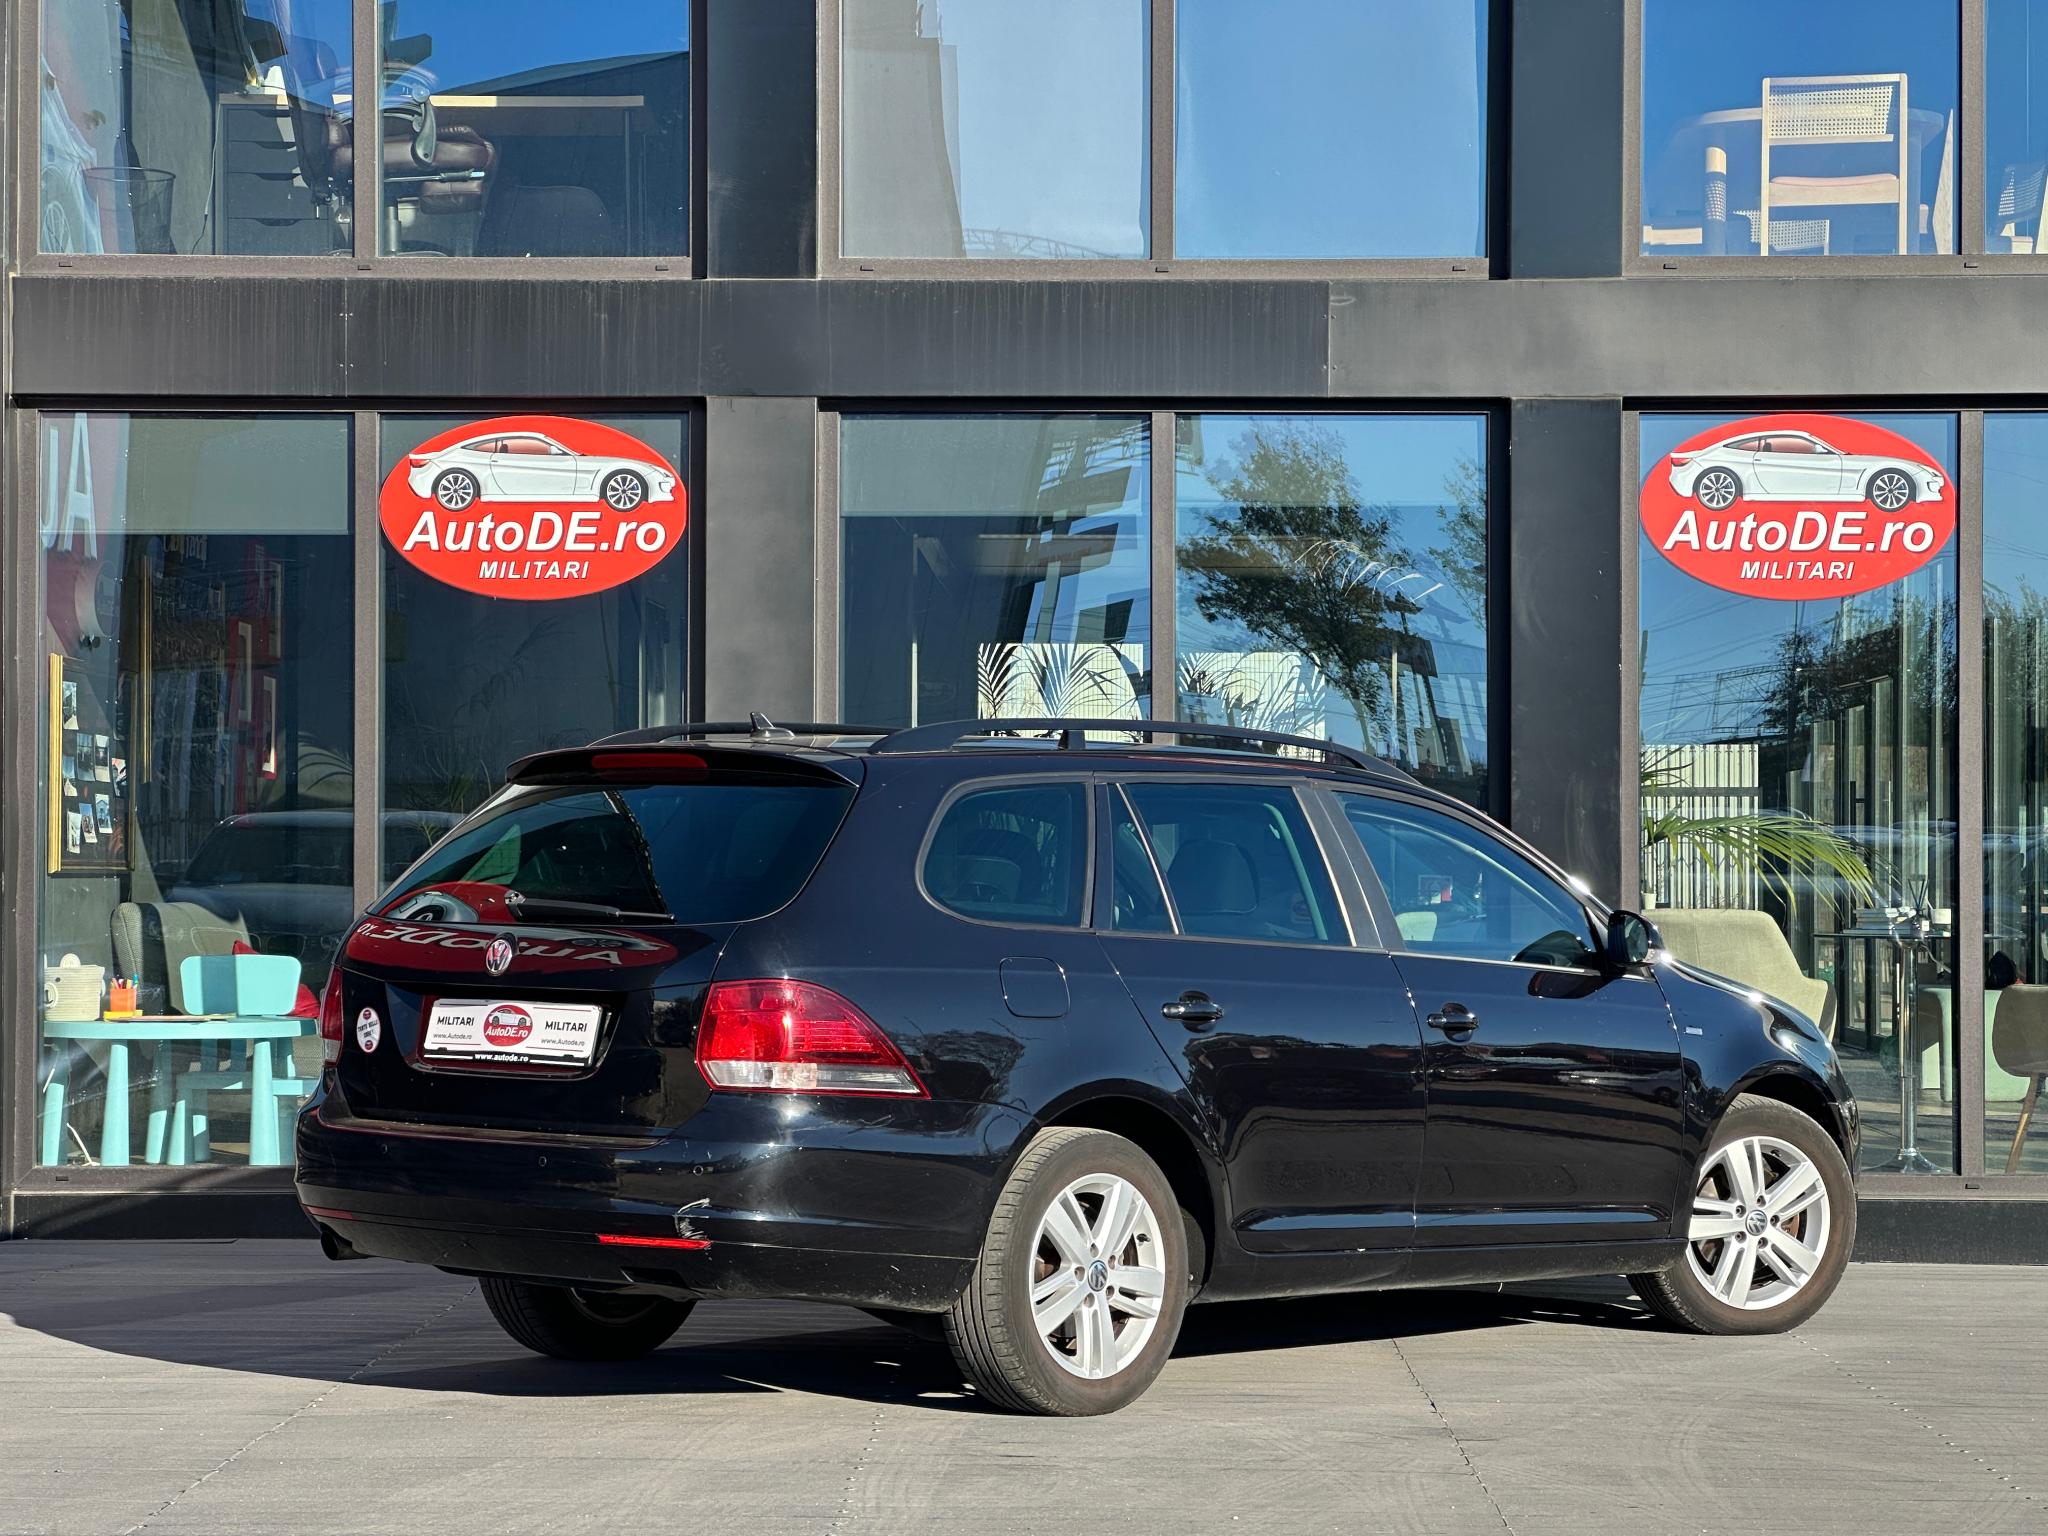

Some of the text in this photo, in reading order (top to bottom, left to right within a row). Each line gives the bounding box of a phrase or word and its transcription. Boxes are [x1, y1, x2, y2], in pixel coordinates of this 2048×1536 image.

[402, 511, 667, 553] AutoDE.ro
[1663, 510, 1935, 553] AutoDE.ro
[478, 561, 590, 579] MILITARI
[1740, 561, 1855, 580] MILITARI
[437, 1016, 475, 1026] MILITARI
[544, 1021, 588, 1032] MILITARI
[485, 1026, 529, 1038] AutoDE.ro
[474, 1053, 529, 1062] www.autode.ro
